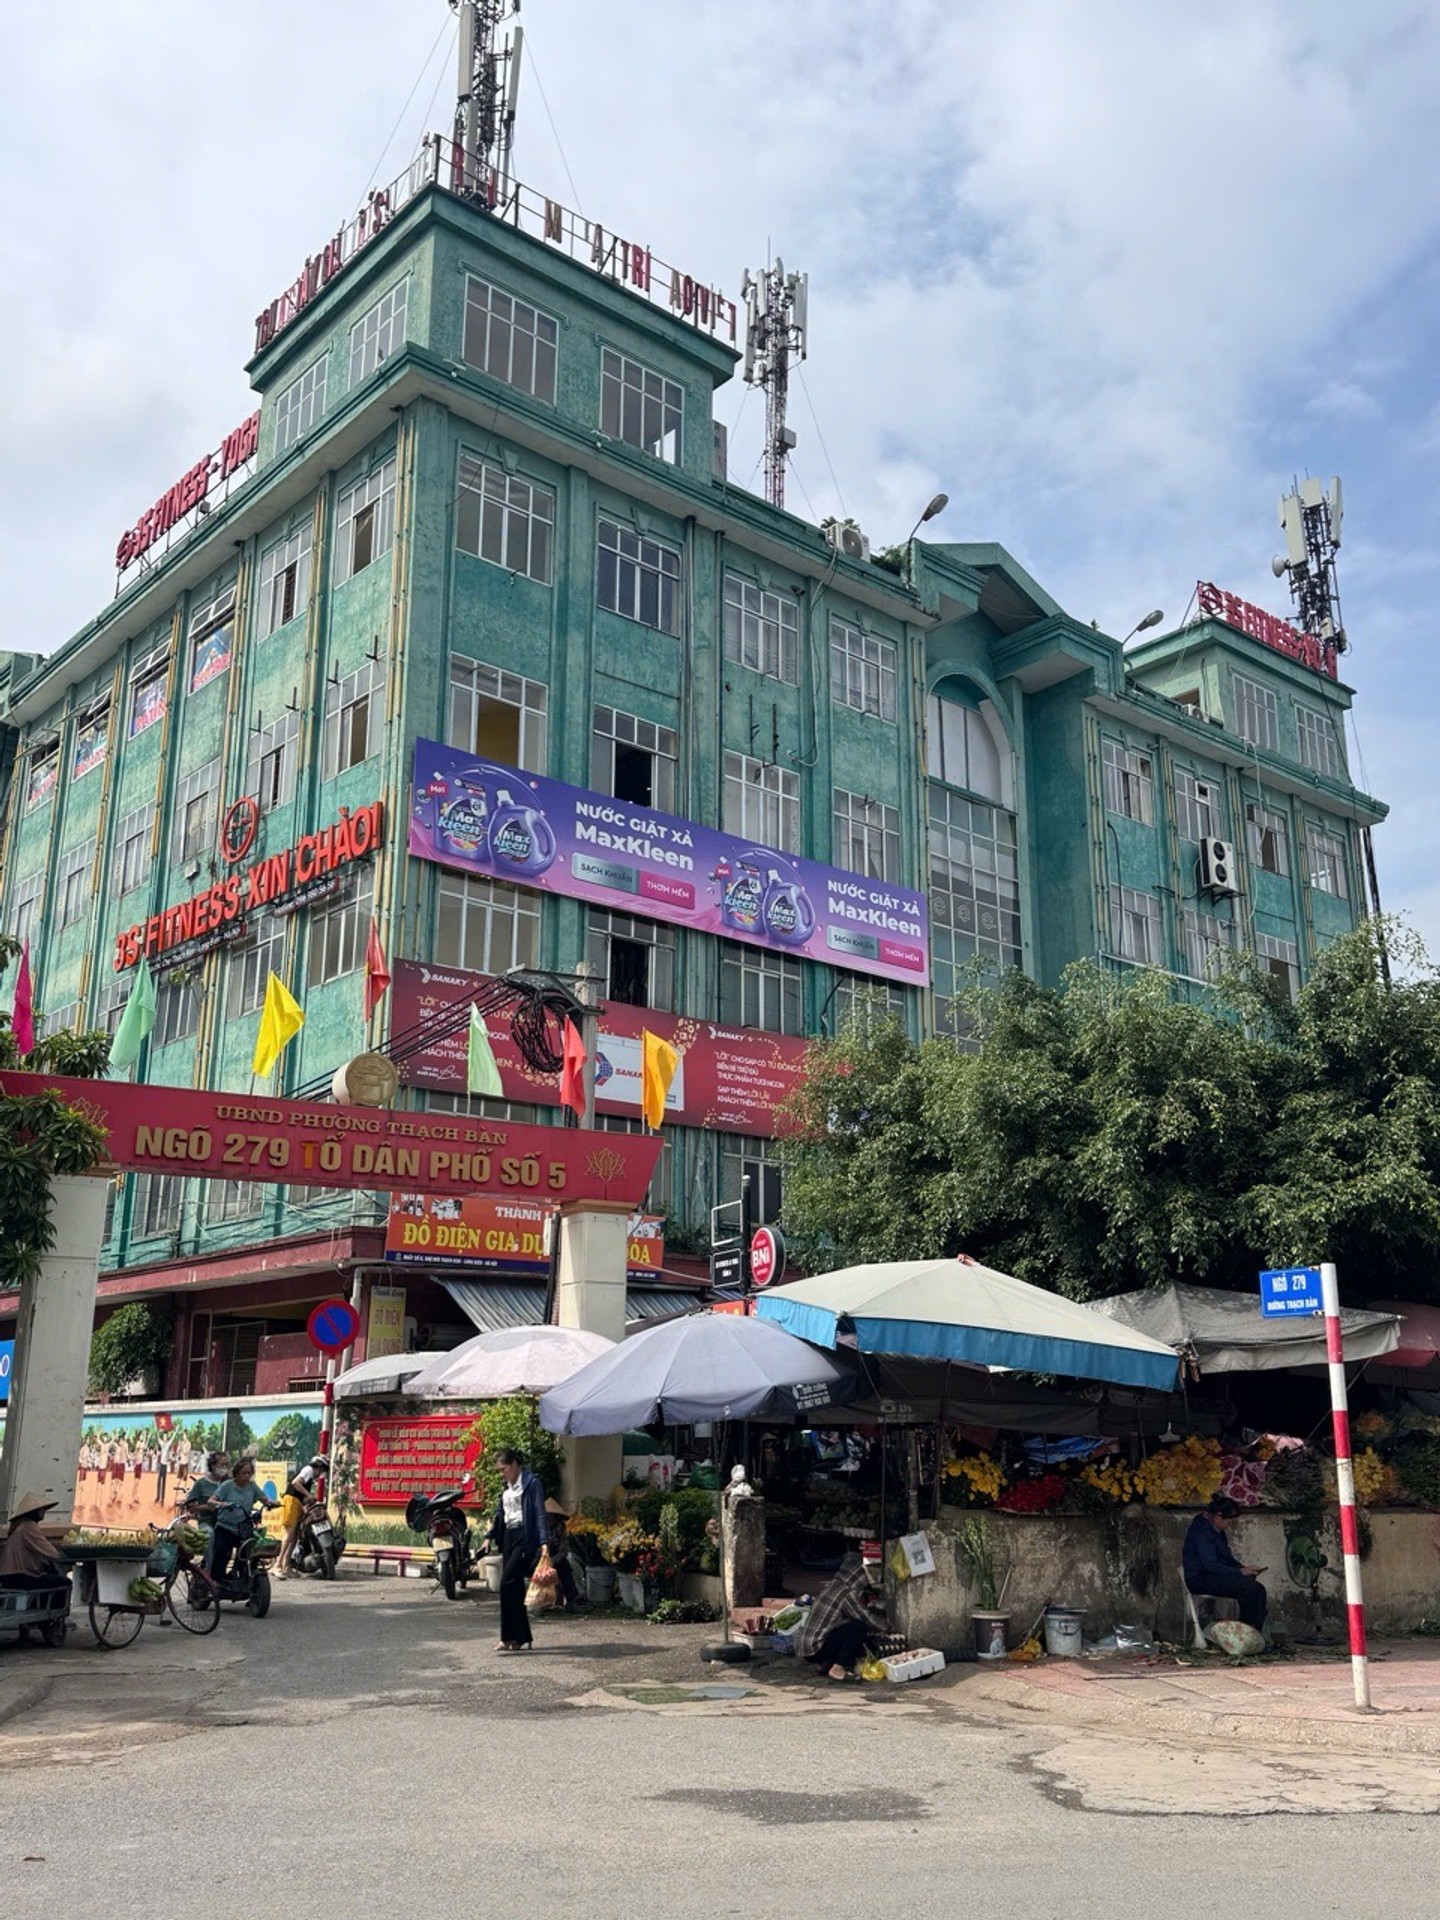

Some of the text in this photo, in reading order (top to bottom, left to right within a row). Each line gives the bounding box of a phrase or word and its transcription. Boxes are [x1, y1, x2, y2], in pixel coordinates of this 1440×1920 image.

[576, 801, 694, 848] NƯỚC GIẶT XẢ
[575, 821, 694, 871] MaxKleen
[113, 923, 142, 972] 3S
[144, 874, 242, 960] FITNESS
[246, 849, 290, 910] XIN
[297, 801, 384, 883] CHÀO!
[828, 880, 920, 916] NƯỚC GIẶT XẢ
[828, 897, 921, 937] MaxKleen
[431, 974, 468, 986] SANAKY
[717, 1031, 744, 1041] SANAKY
[216, 1105, 508, 1145] UBND PHƯỜNG THẠCH BÀN
[134, 1124, 567, 1189] NGÕ 279 TỔ DÂN PHỐ SỐ 5
[403, 1214, 651, 1264] ĐỒ ĐIỆN GIA DỤ ÓA
[1292, 1274, 1306, 1291] 279
